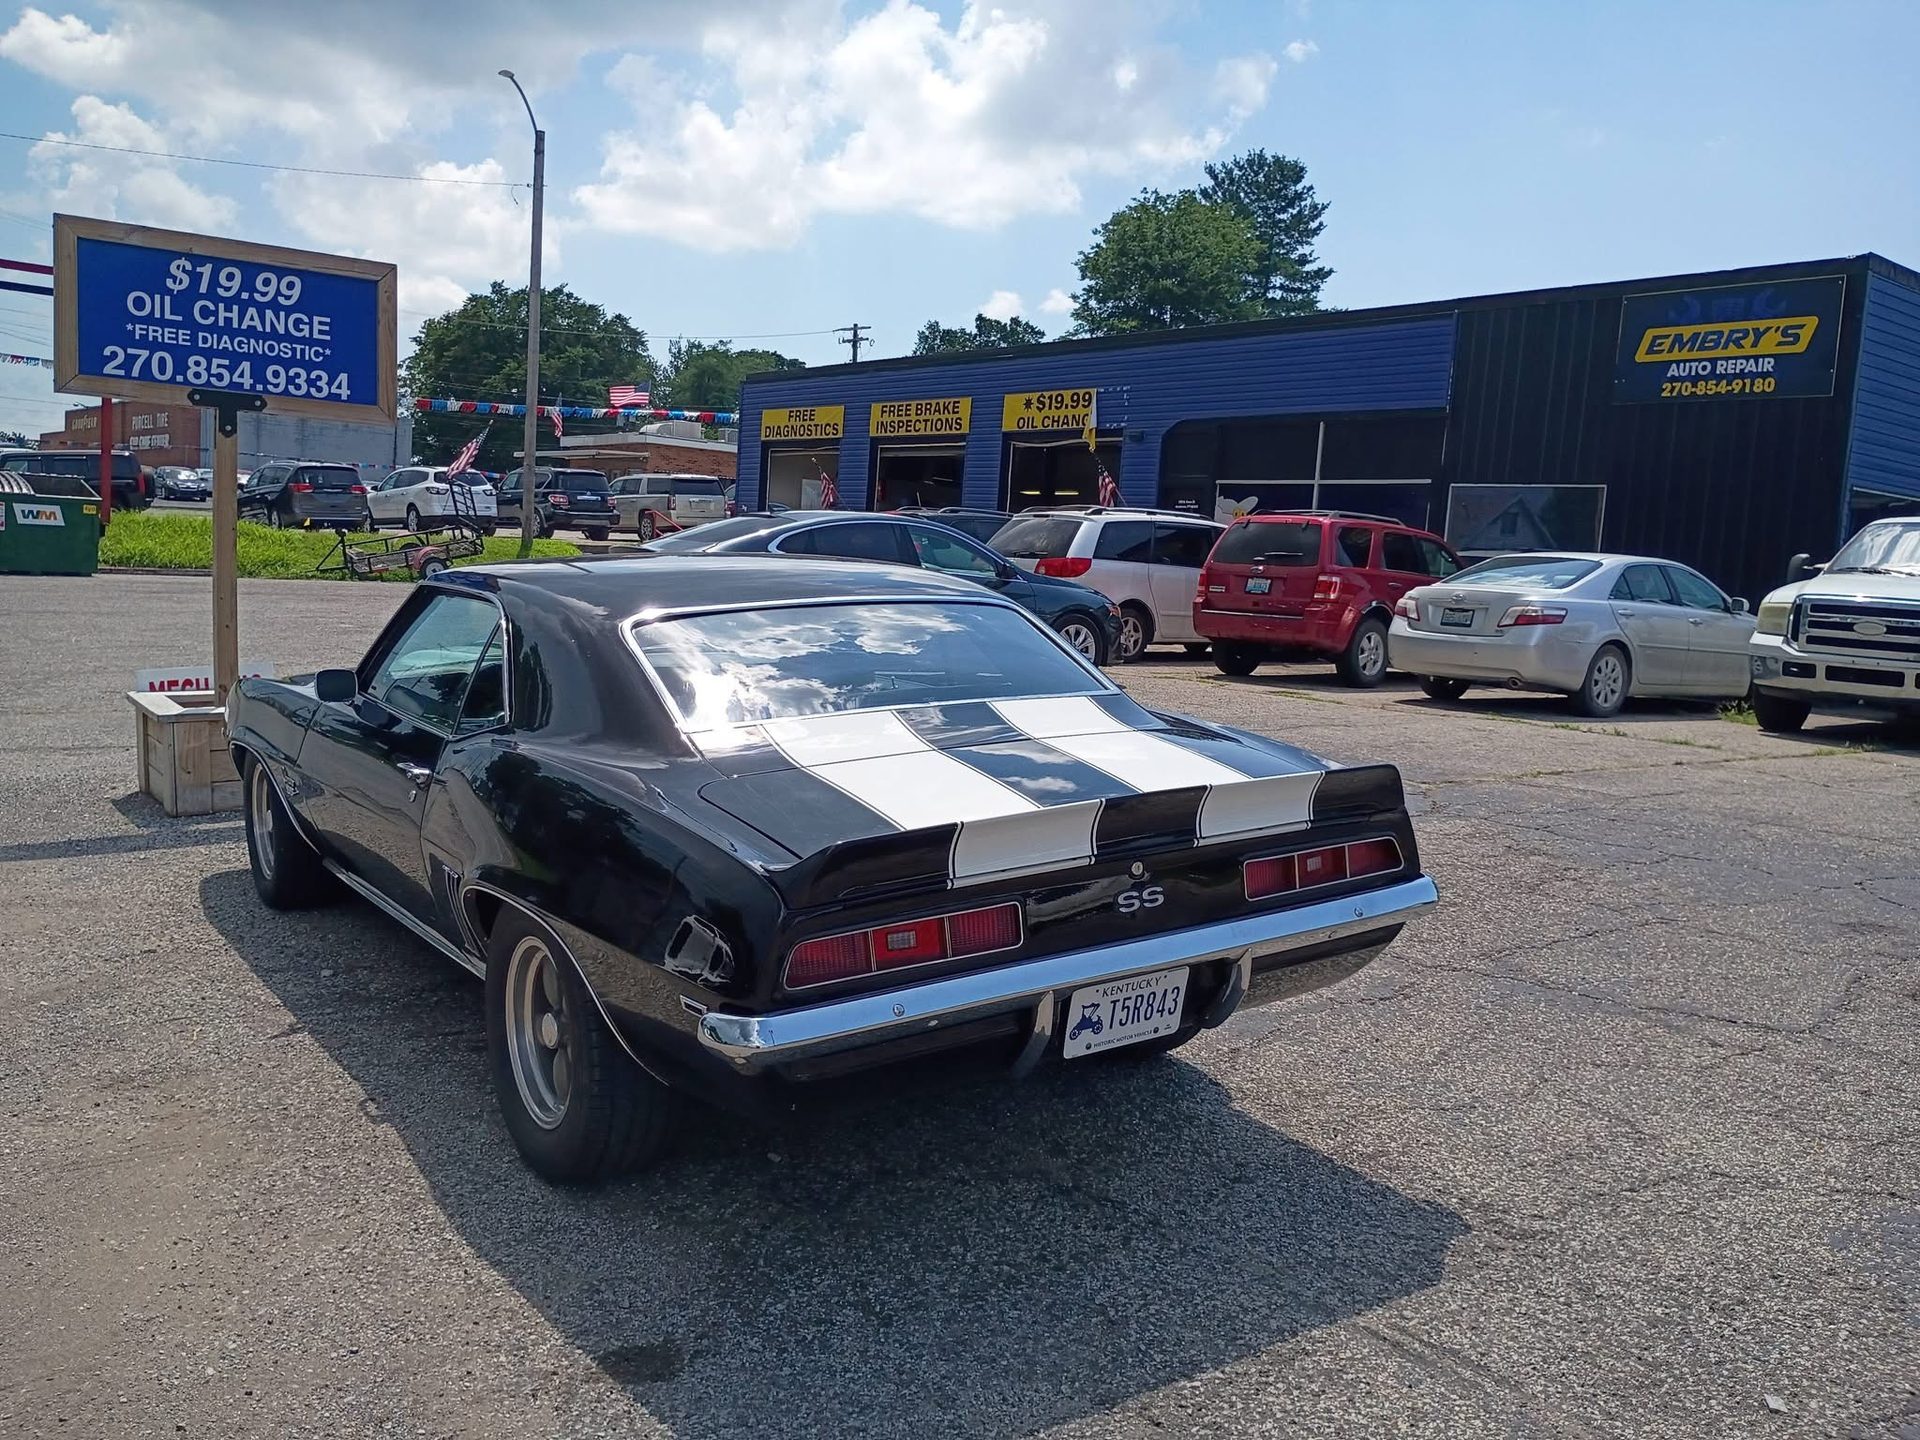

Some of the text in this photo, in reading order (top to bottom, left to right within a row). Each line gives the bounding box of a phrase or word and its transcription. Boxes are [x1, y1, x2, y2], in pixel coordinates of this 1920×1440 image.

[166, 257, 302, 306] $19.99
[127, 291, 331, 341] OIL CHANGE
[1645, 323, 1808, 356] EMBRY'S
[102, 345, 351, 401] 270.854.9334
[1666, 357, 1775, 378] AUTO REPAIR
[1661, 377, 1776, 397] 270-854-9180
[788, 409, 816, 423] FREE
[880, 400, 960, 419] FREE BRAKE
[765, 422, 839, 438] DIAGNOSTICS
[876, 417, 963, 434] INSPECTIONS
[1017, 413, 1089, 430] OIL CHANG
[21, 509, 58, 521] WM
[1117, 886, 1165, 913] SS
[1102, 976, 1162, 998] KENTUCKY
[1109, 986, 1180, 1030] T5R843
